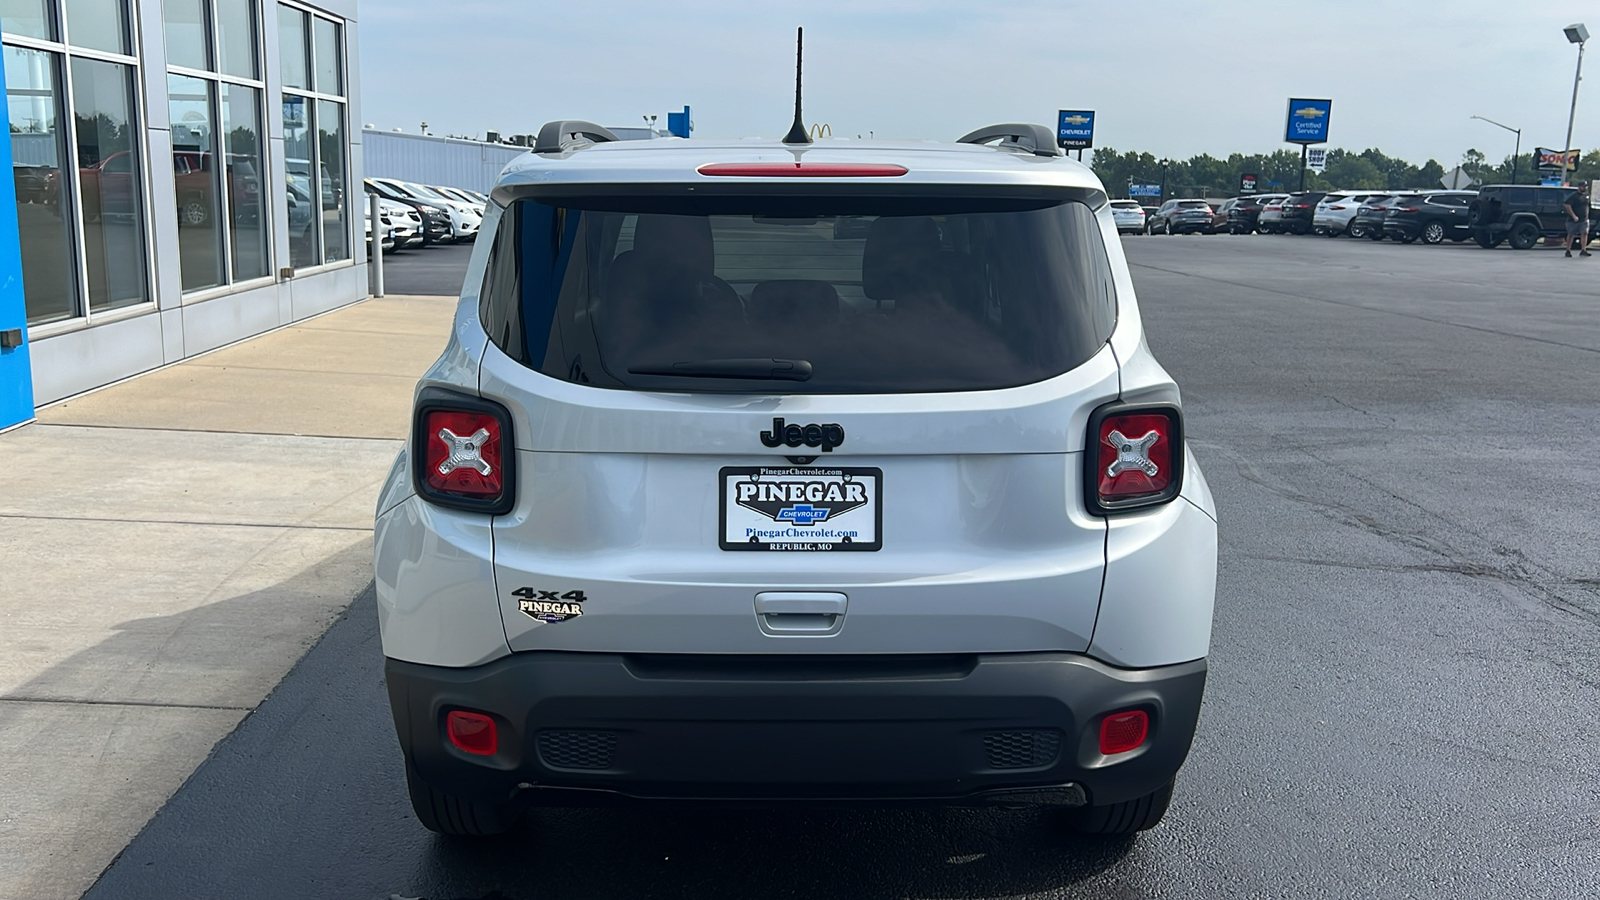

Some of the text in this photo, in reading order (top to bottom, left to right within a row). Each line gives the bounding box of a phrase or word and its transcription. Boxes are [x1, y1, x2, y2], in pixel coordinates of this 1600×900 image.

[1295, 121, 1322, 129] Certified
[1539, 154, 1575, 164] SONC
[760, 417, 845, 452] Jeep
[760, 468, 843, 476] PinegarChevrolet.com
[739, 484, 865, 502] PINEGAR
[745, 528, 857, 538] PinegarChevrolet.com
[769, 543, 816, 551] REPUBLIC,
[512, 587, 587, 603] 4x4
[520, 601, 582, 615] PINEGAR
